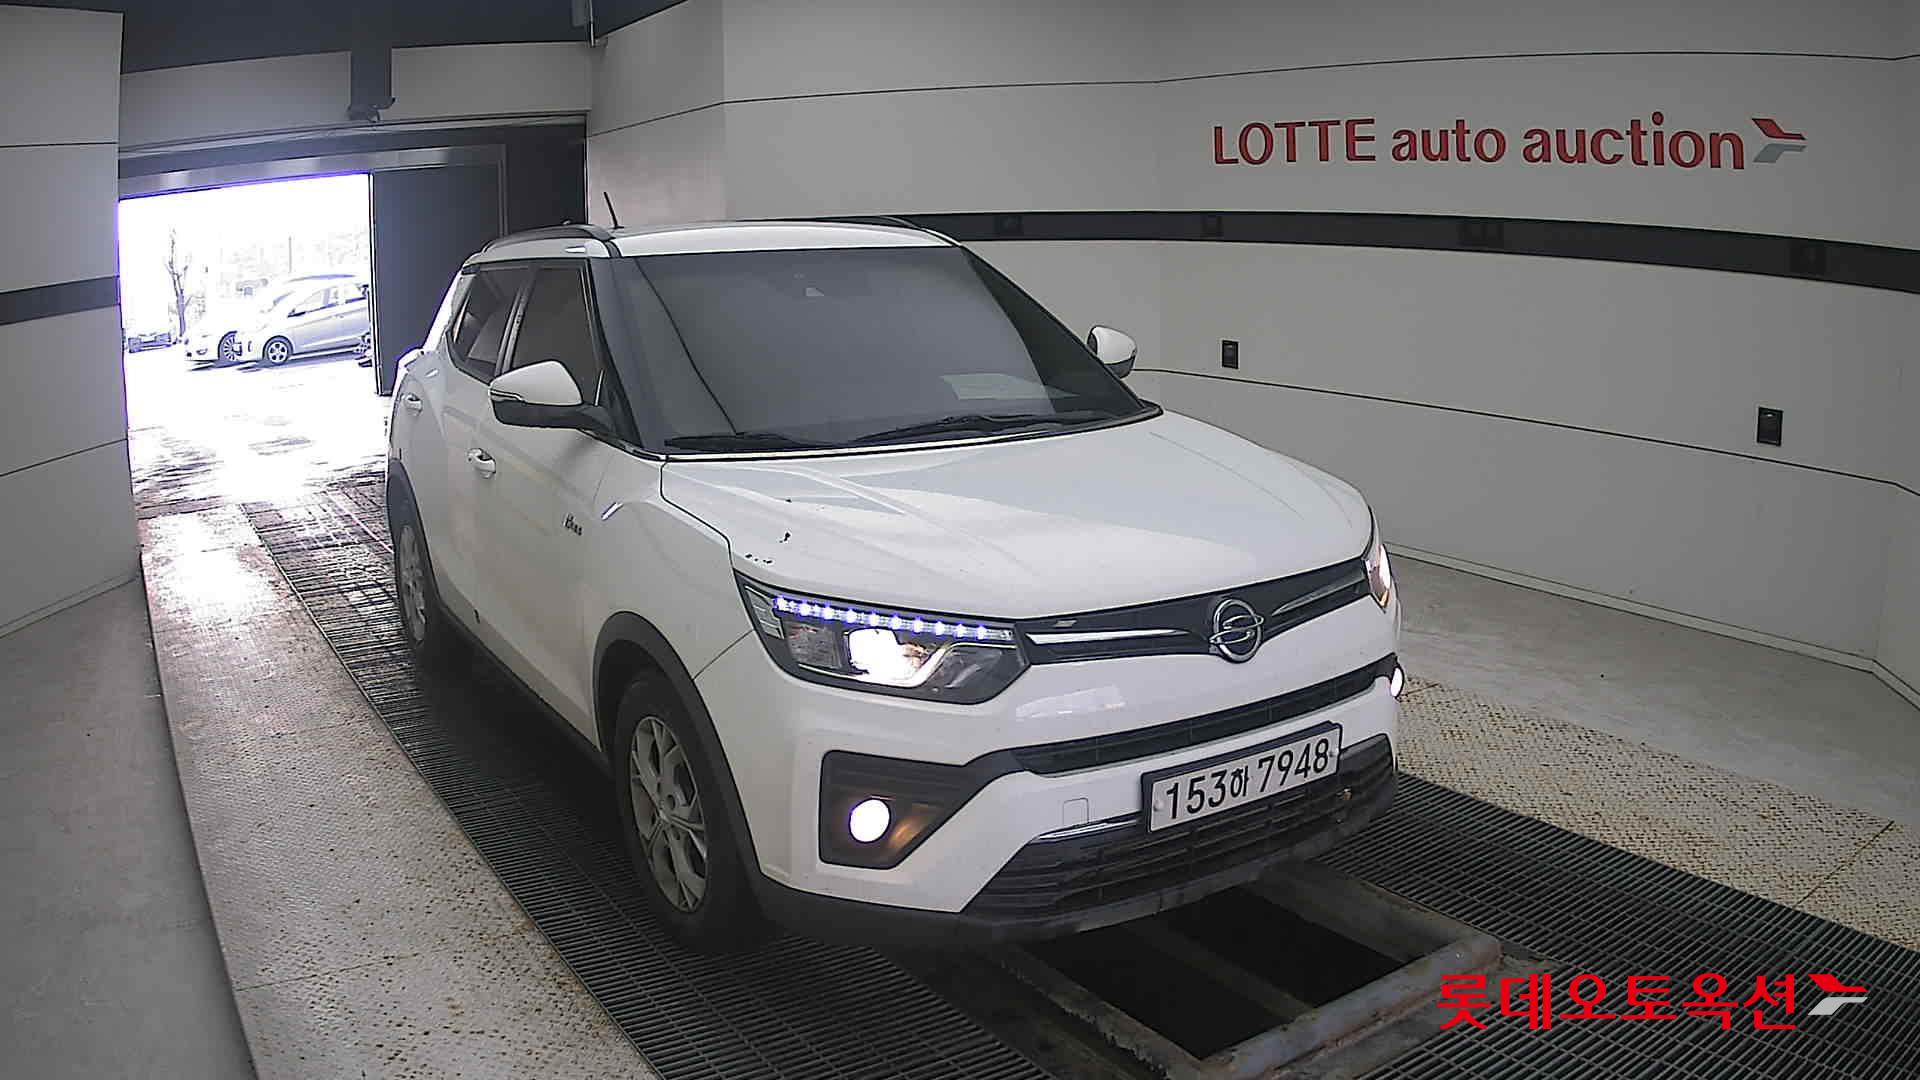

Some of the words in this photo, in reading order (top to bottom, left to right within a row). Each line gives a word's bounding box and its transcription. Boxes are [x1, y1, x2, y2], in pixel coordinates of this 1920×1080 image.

[1213, 117, 1377, 165] LOTTE
[1391, 118, 1507, 162] auto
[1521, 111, 1745, 169] auction
[1165, 764, 1250, 820] 153하
[1257, 738, 1330, 793] 7948
